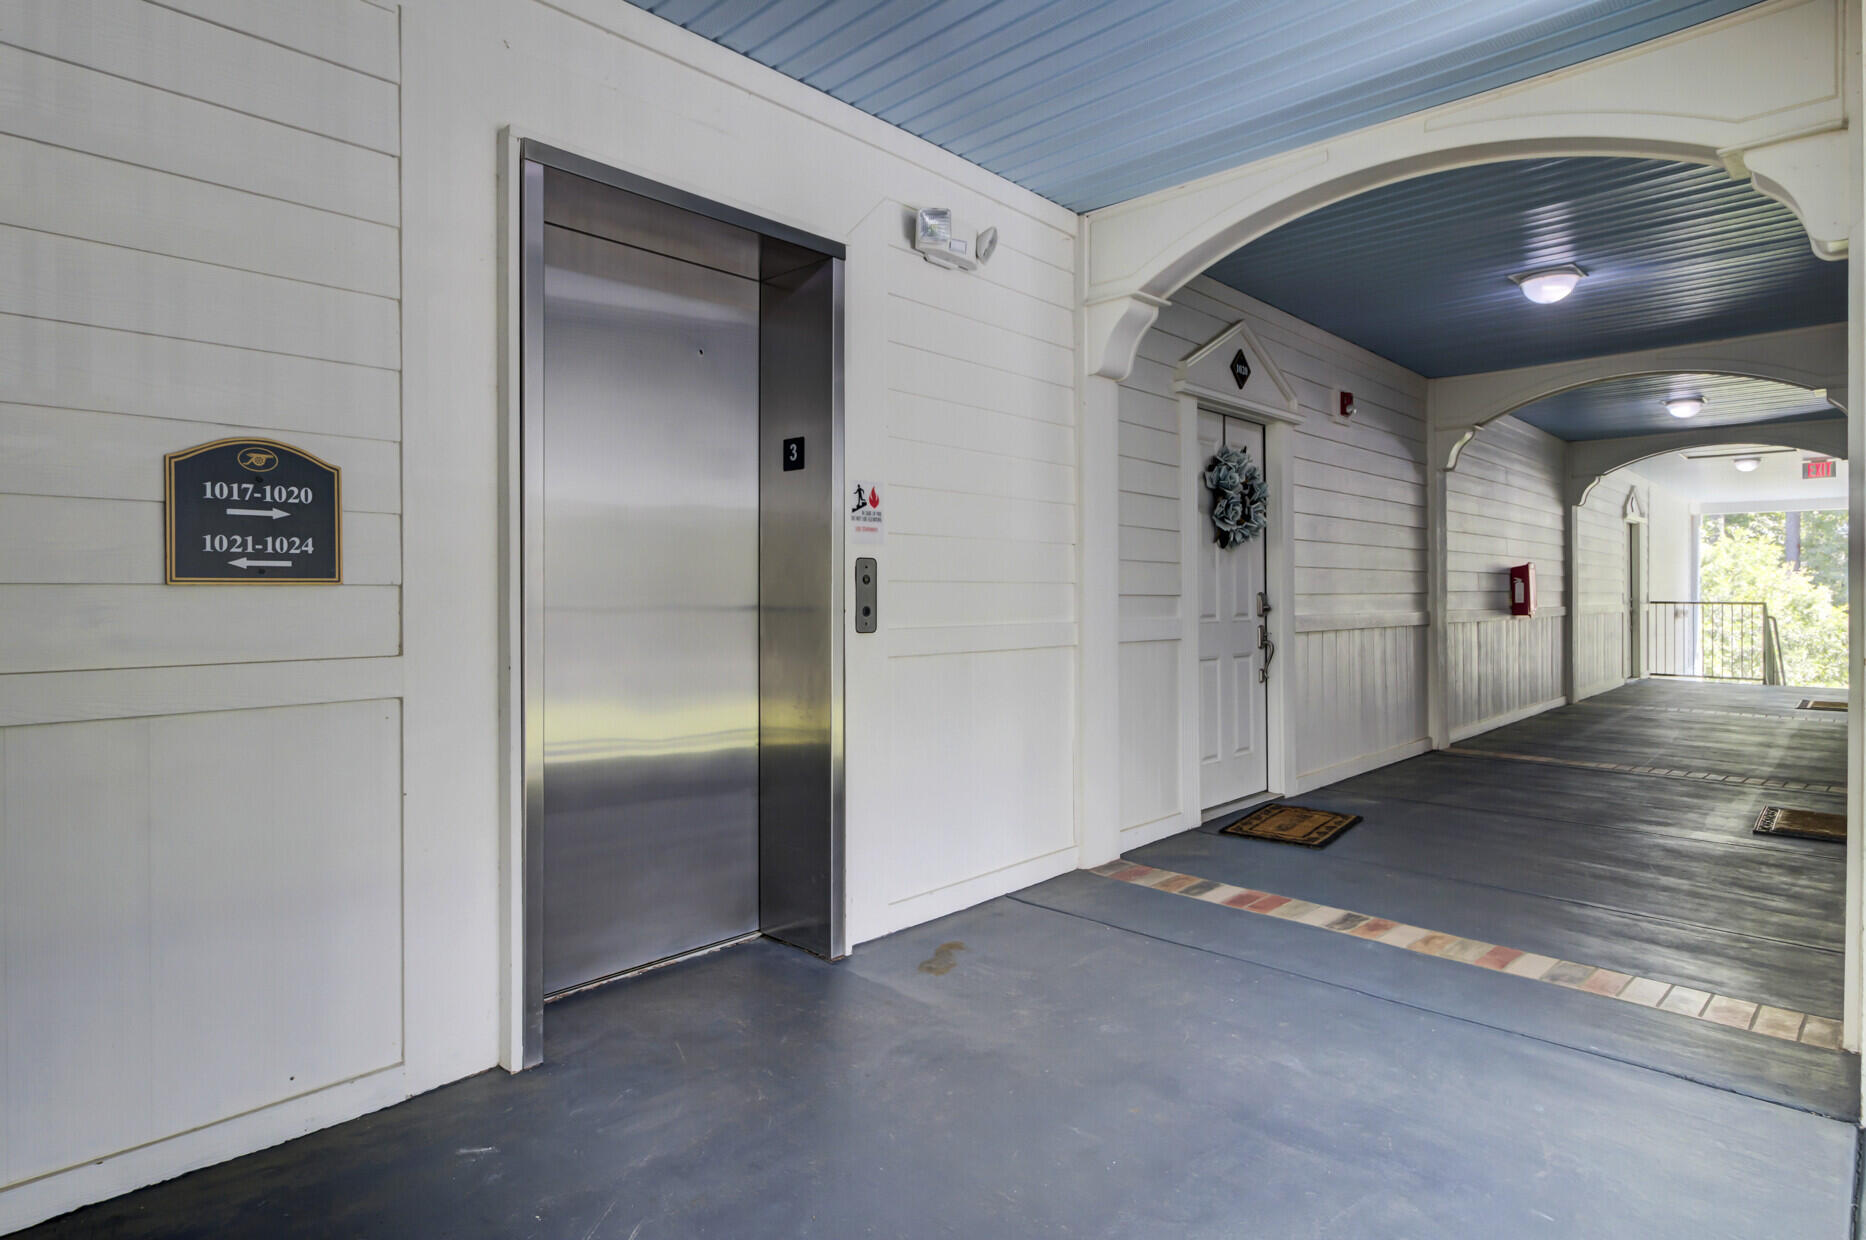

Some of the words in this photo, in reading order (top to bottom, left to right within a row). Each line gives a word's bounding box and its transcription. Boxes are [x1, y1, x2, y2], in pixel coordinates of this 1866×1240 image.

[789, 443, 798, 461] 3
[1807, 462, 1833, 478] EXIT
[202, 481, 313, 504] 1017-1020
[202, 534, 314, 554] 1021-1024
